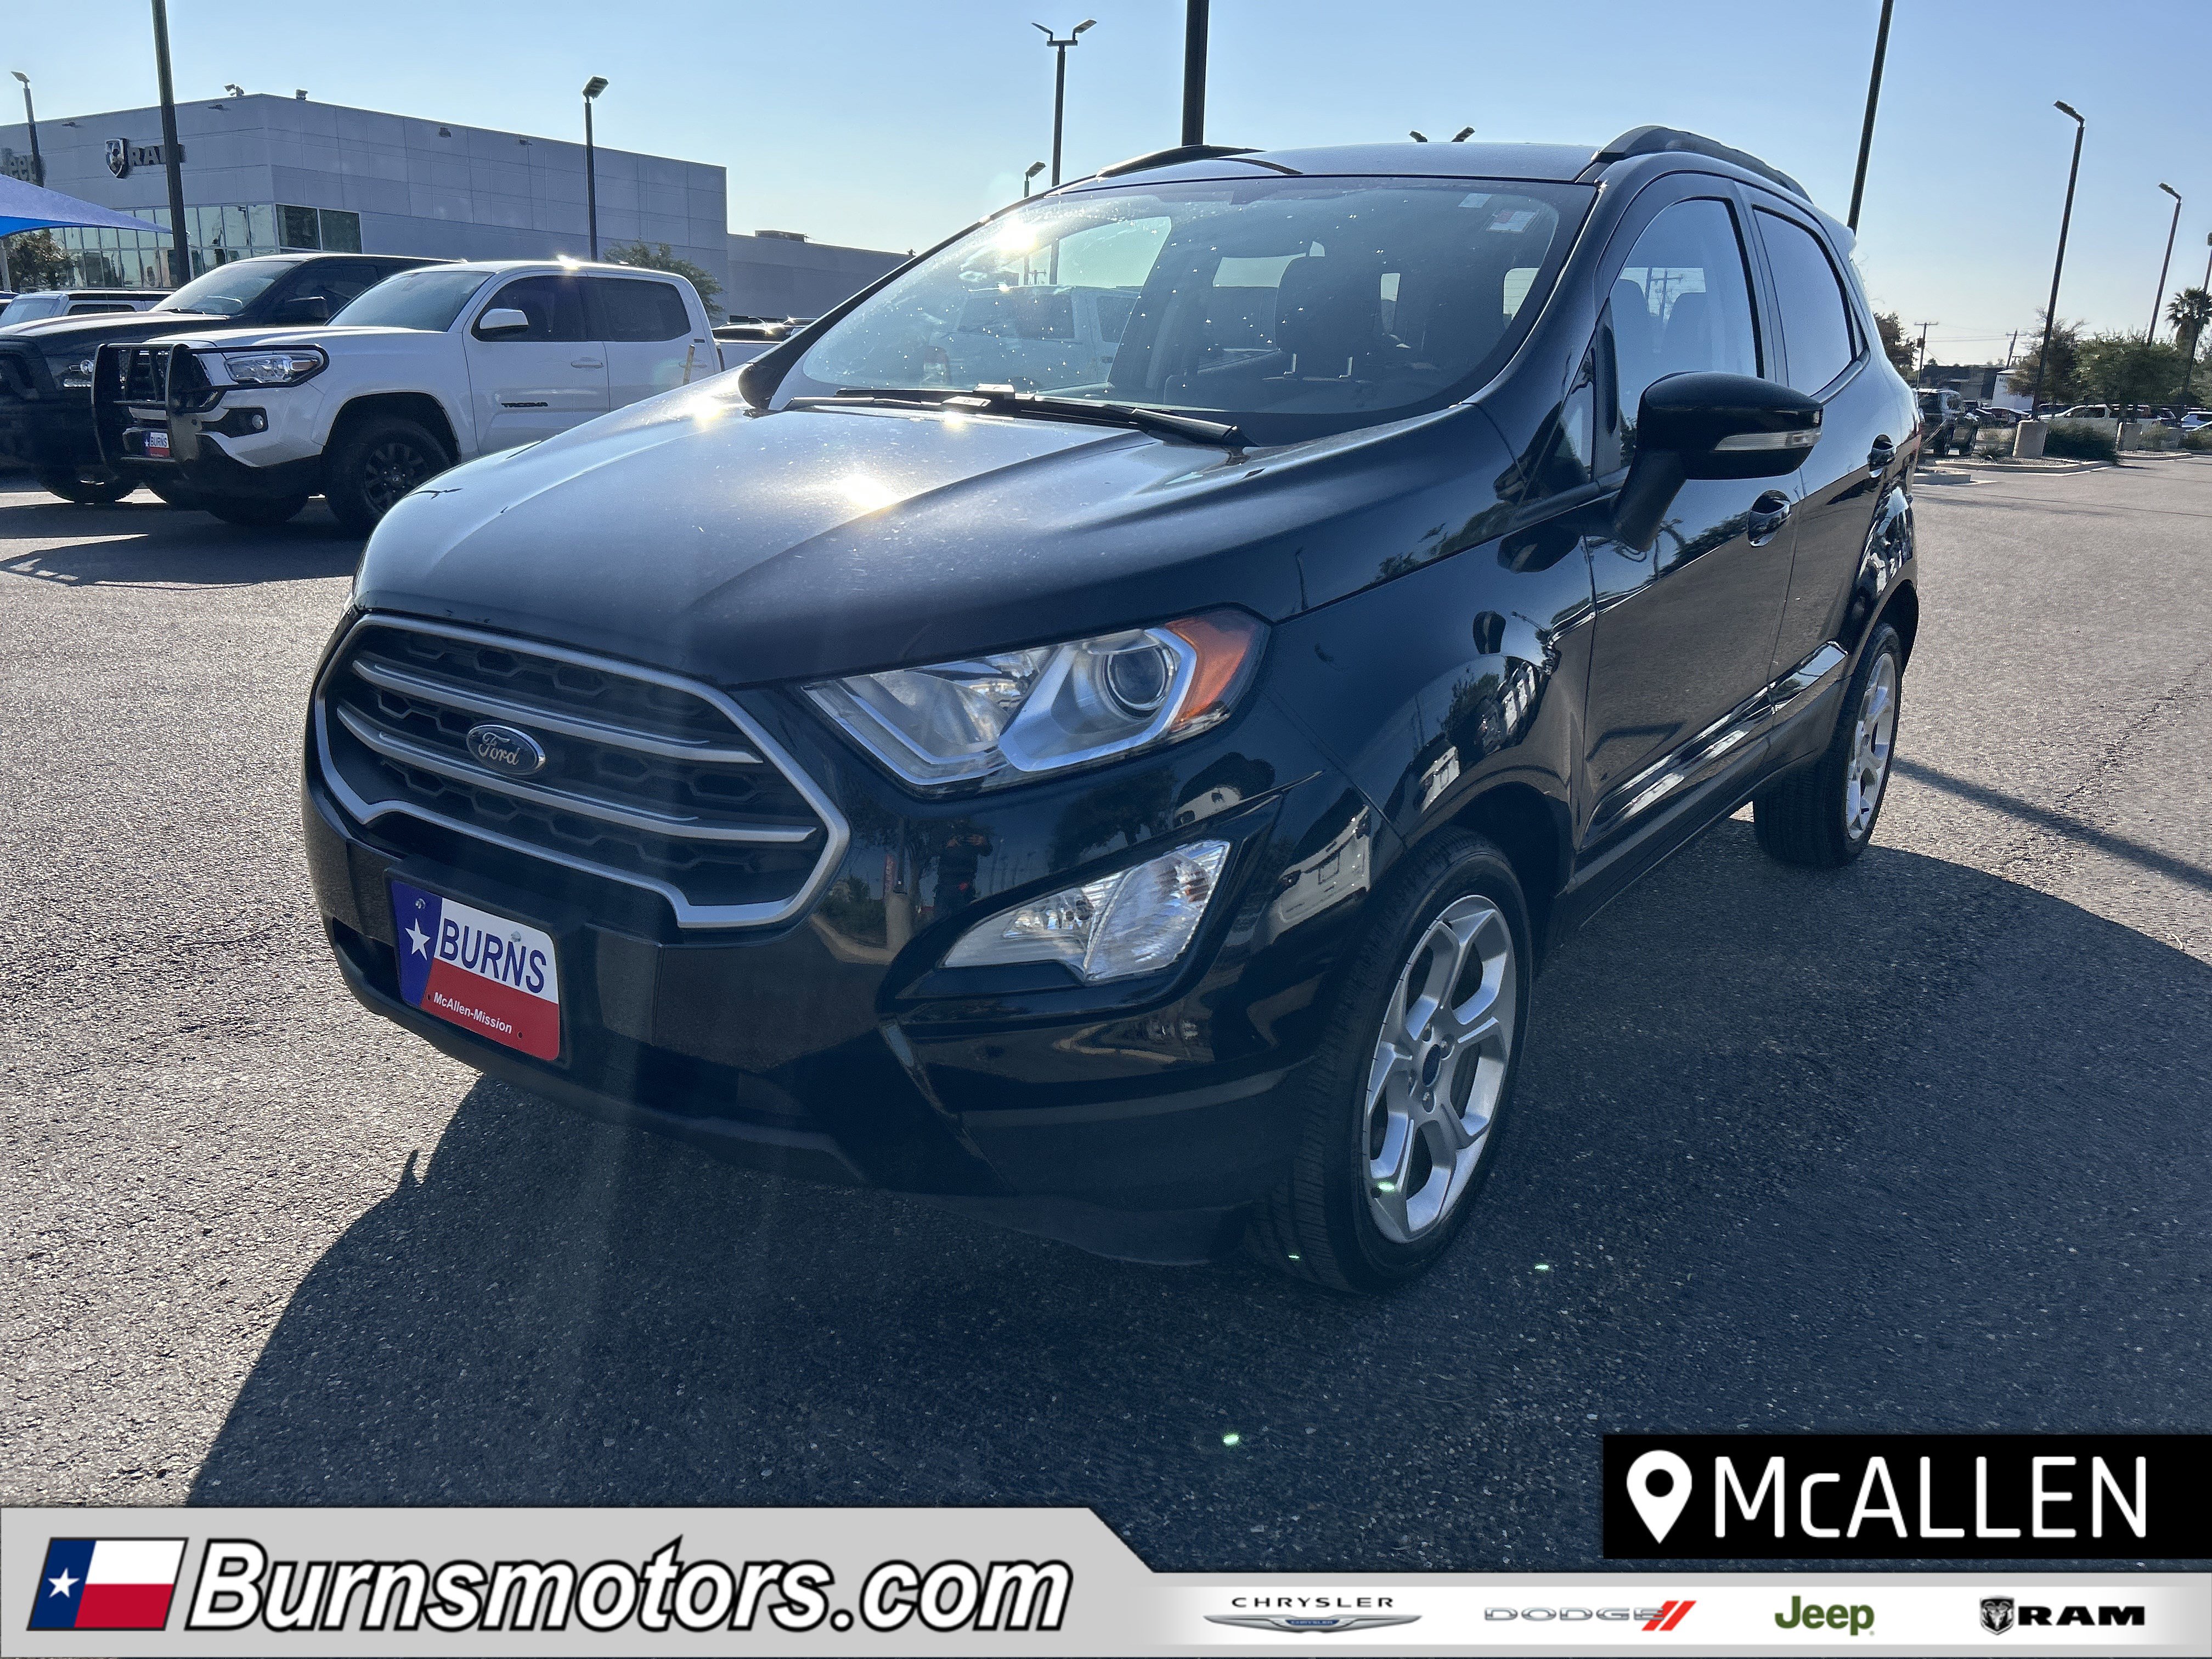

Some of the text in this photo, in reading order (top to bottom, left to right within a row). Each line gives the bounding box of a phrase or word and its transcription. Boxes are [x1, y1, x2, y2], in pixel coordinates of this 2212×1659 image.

[150, 436, 167, 447] BURNS
[478, 731, 521, 765] Ford
[439, 918, 547, 994] BURNS
[433, 991, 512, 1034] McAllen-Mission
